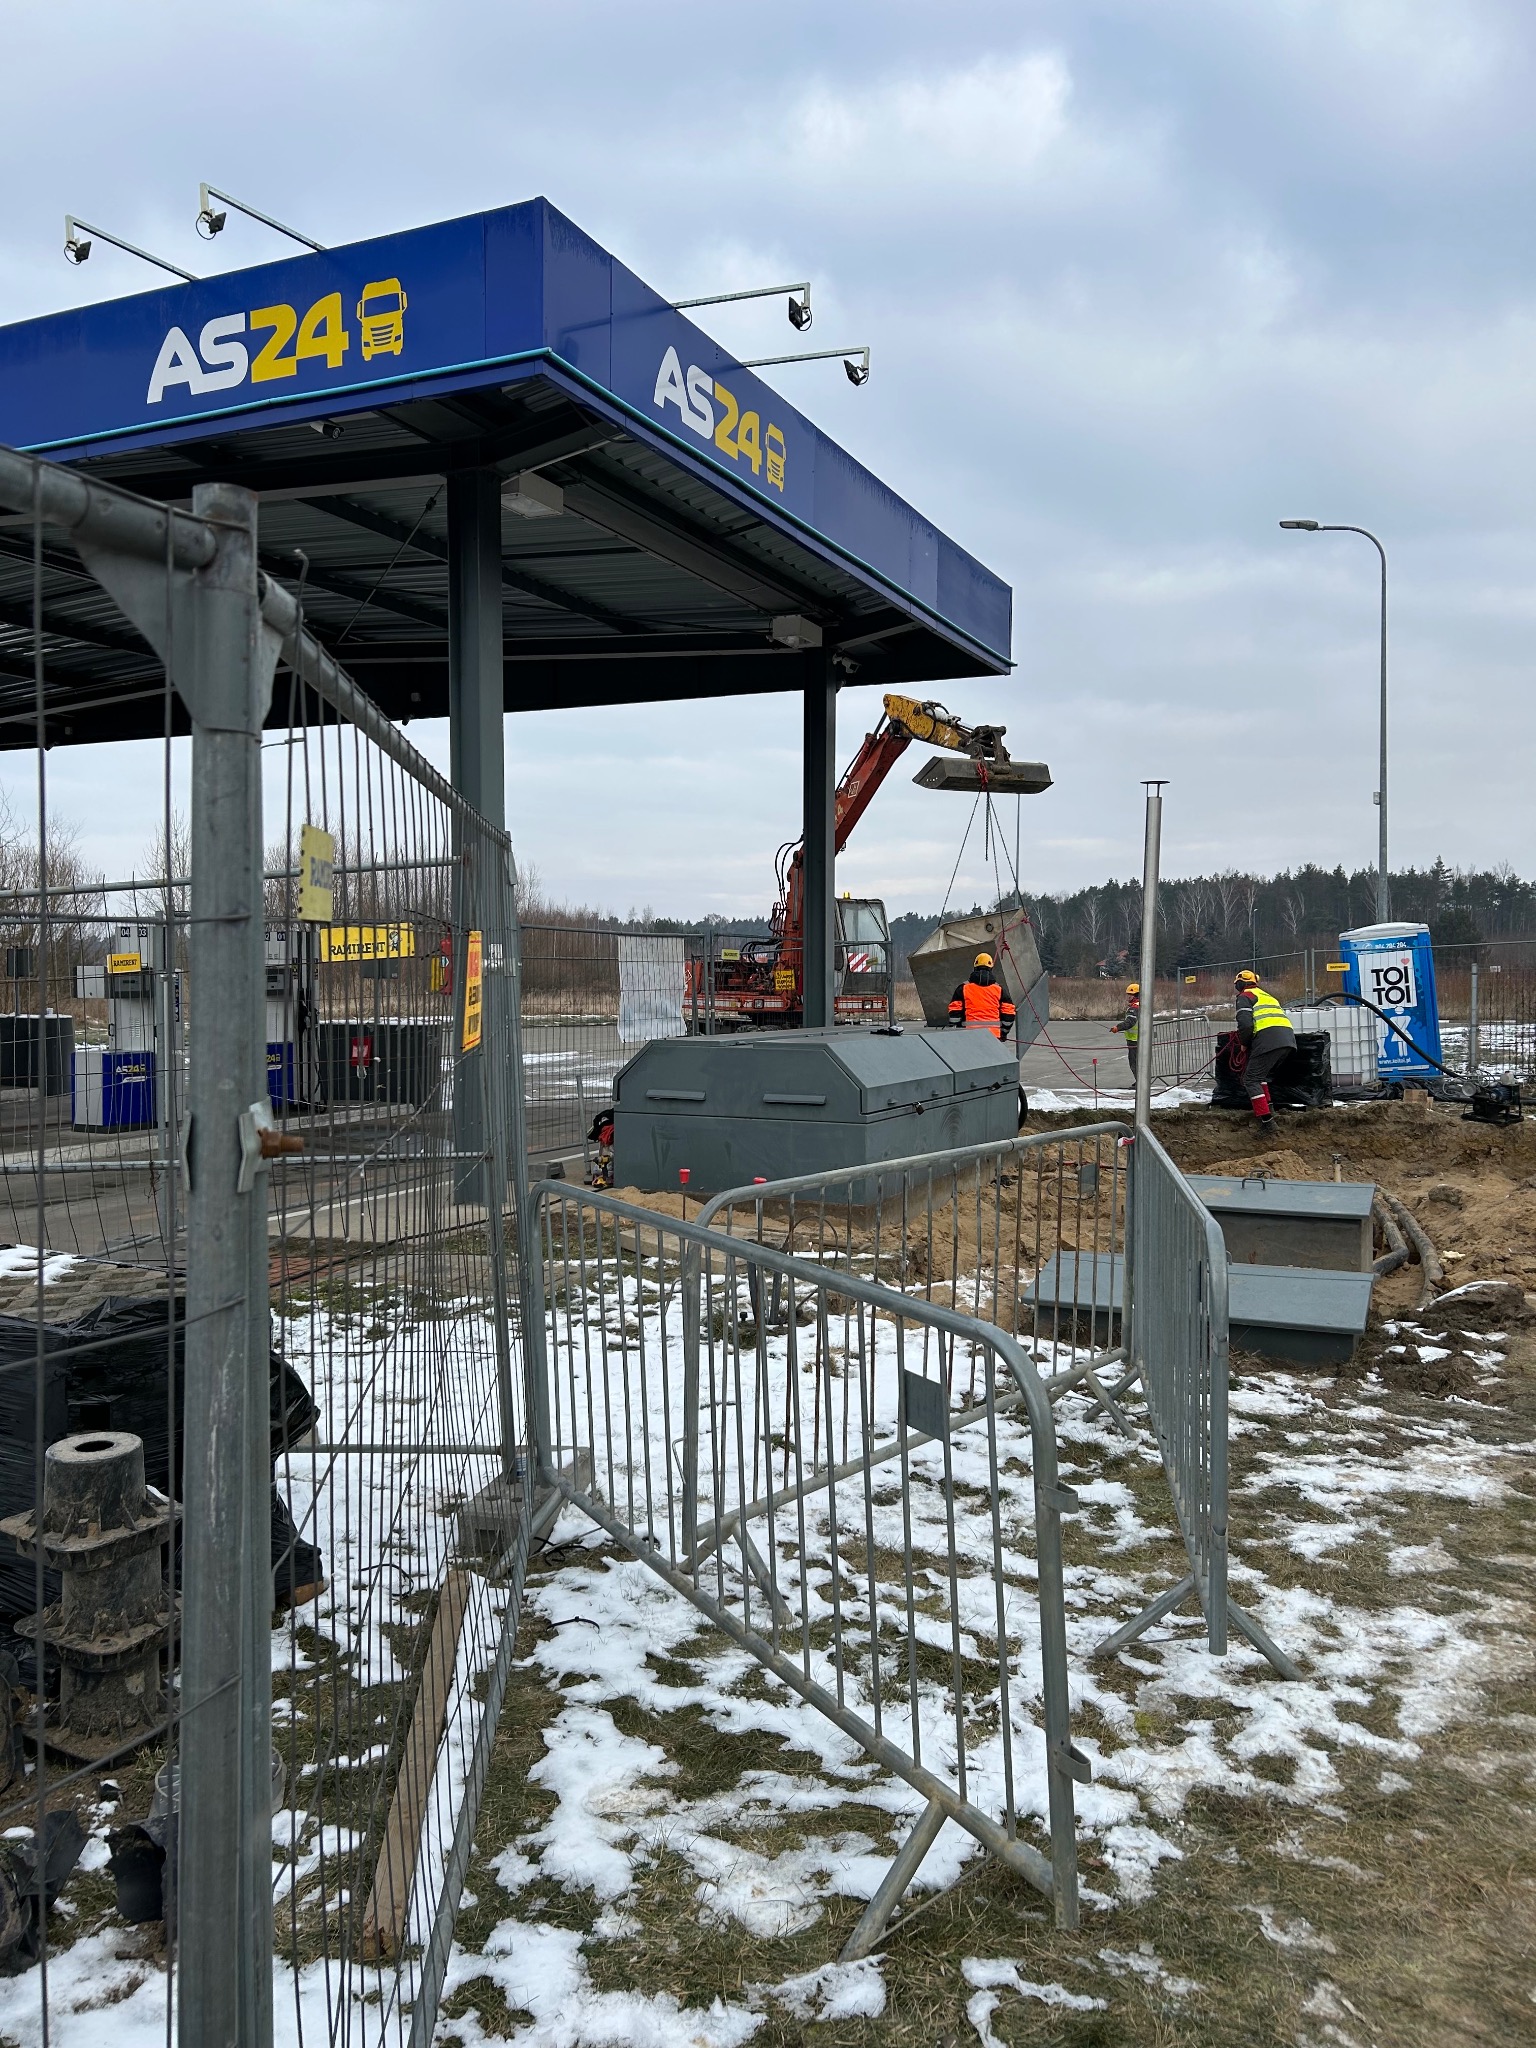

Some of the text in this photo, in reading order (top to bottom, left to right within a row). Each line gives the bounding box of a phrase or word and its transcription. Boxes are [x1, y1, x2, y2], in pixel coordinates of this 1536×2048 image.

[146, 291, 350, 405] AS24
[653, 345, 763, 476] AS24
[121, 928, 130, 937] 04
[277, 932, 286, 941] 01
[113, 958, 138, 967] RAMIRENT
[1371, 966, 1410, 987] TOI
[1373, 985, 1412, 1006] TOI
[115, 1063, 140, 1073] AS24
